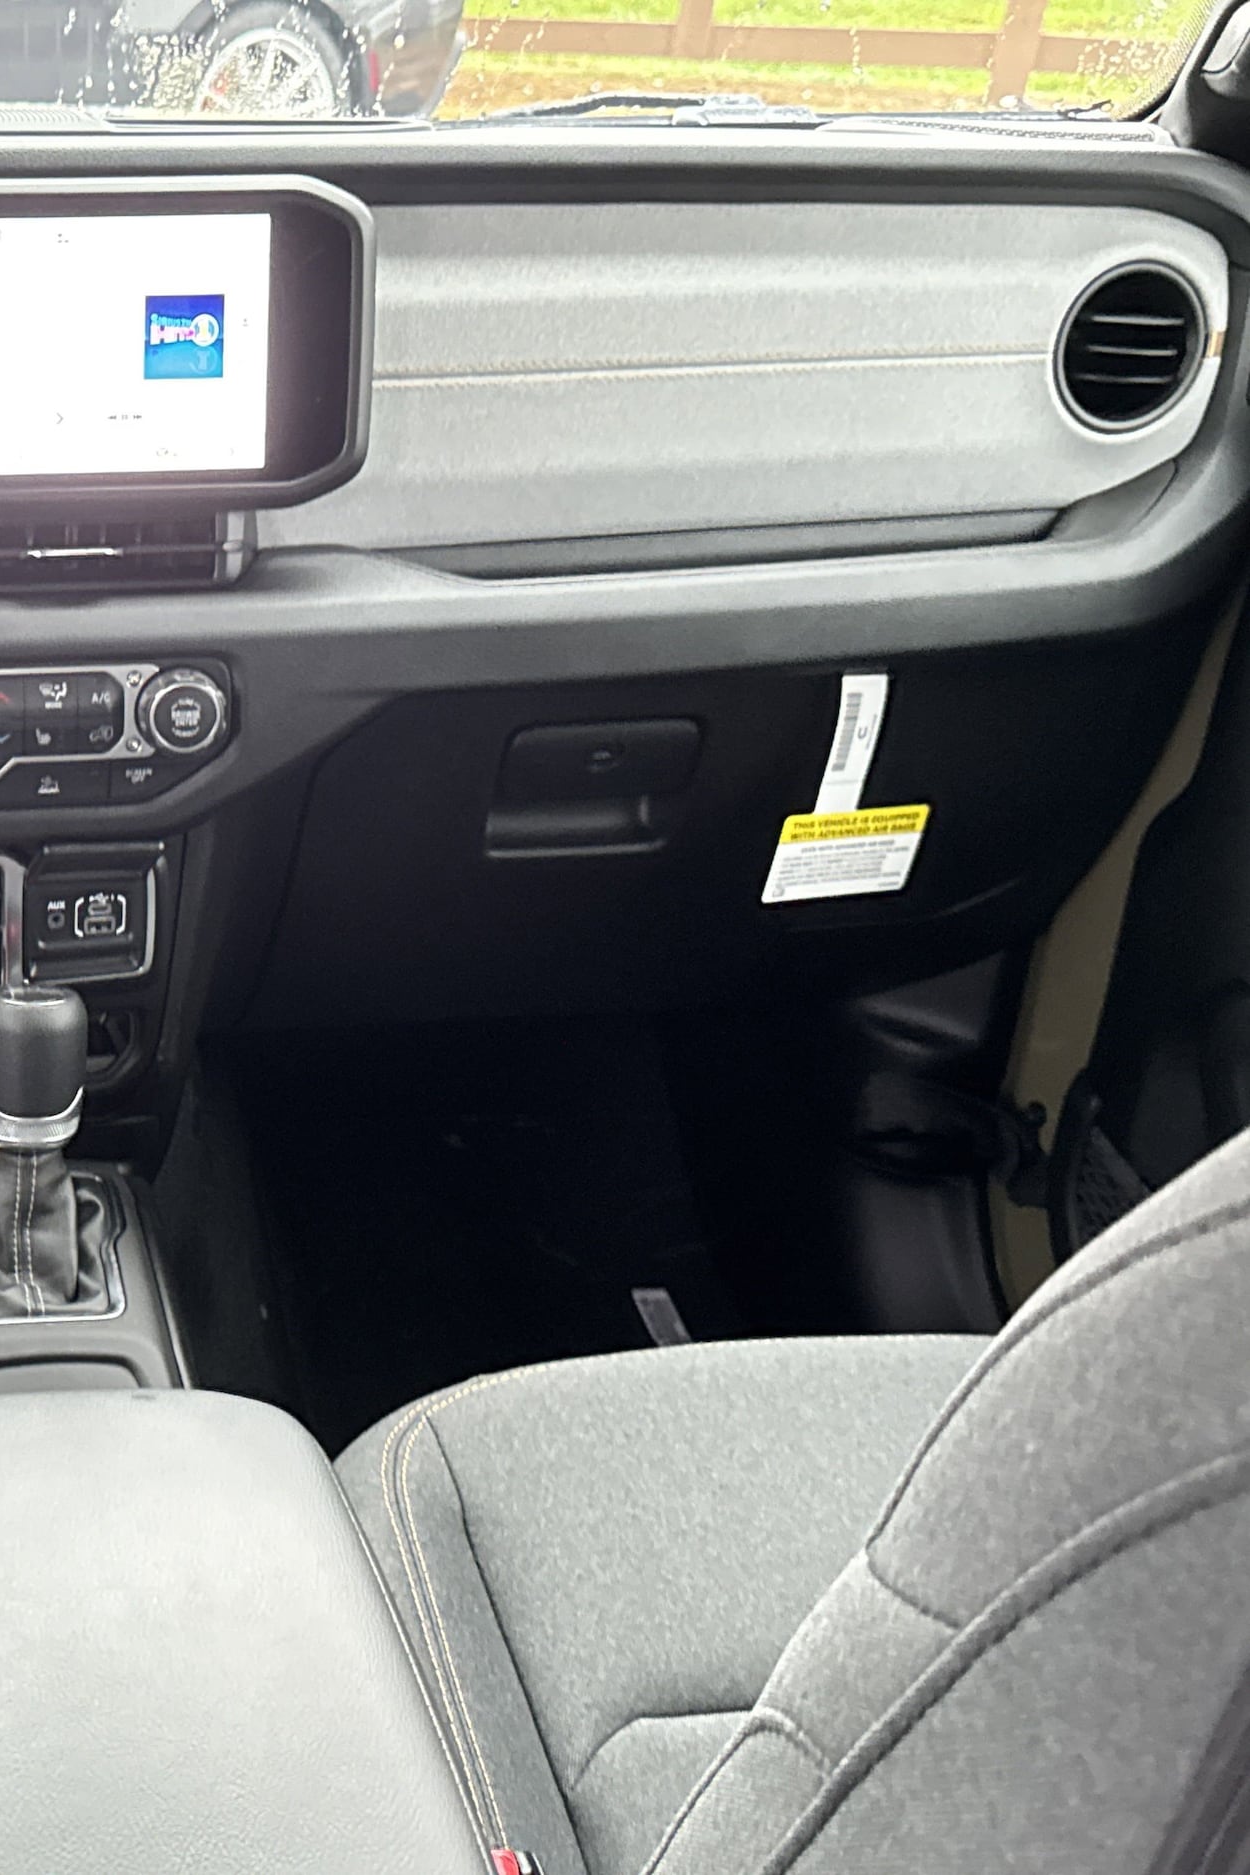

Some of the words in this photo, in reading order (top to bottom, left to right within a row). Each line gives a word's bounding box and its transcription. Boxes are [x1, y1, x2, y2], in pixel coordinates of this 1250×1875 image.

[91, 690, 111, 705] A/C
[817, 816, 859, 829] VEHICLE
[871, 811, 921, 824] EQUIPPED
[790, 831, 816, 841] WITH
[817, 825, 871, 839] ADVANCED
[873, 823, 890, 834] AIR
[46, 899, 66, 912] AUX
